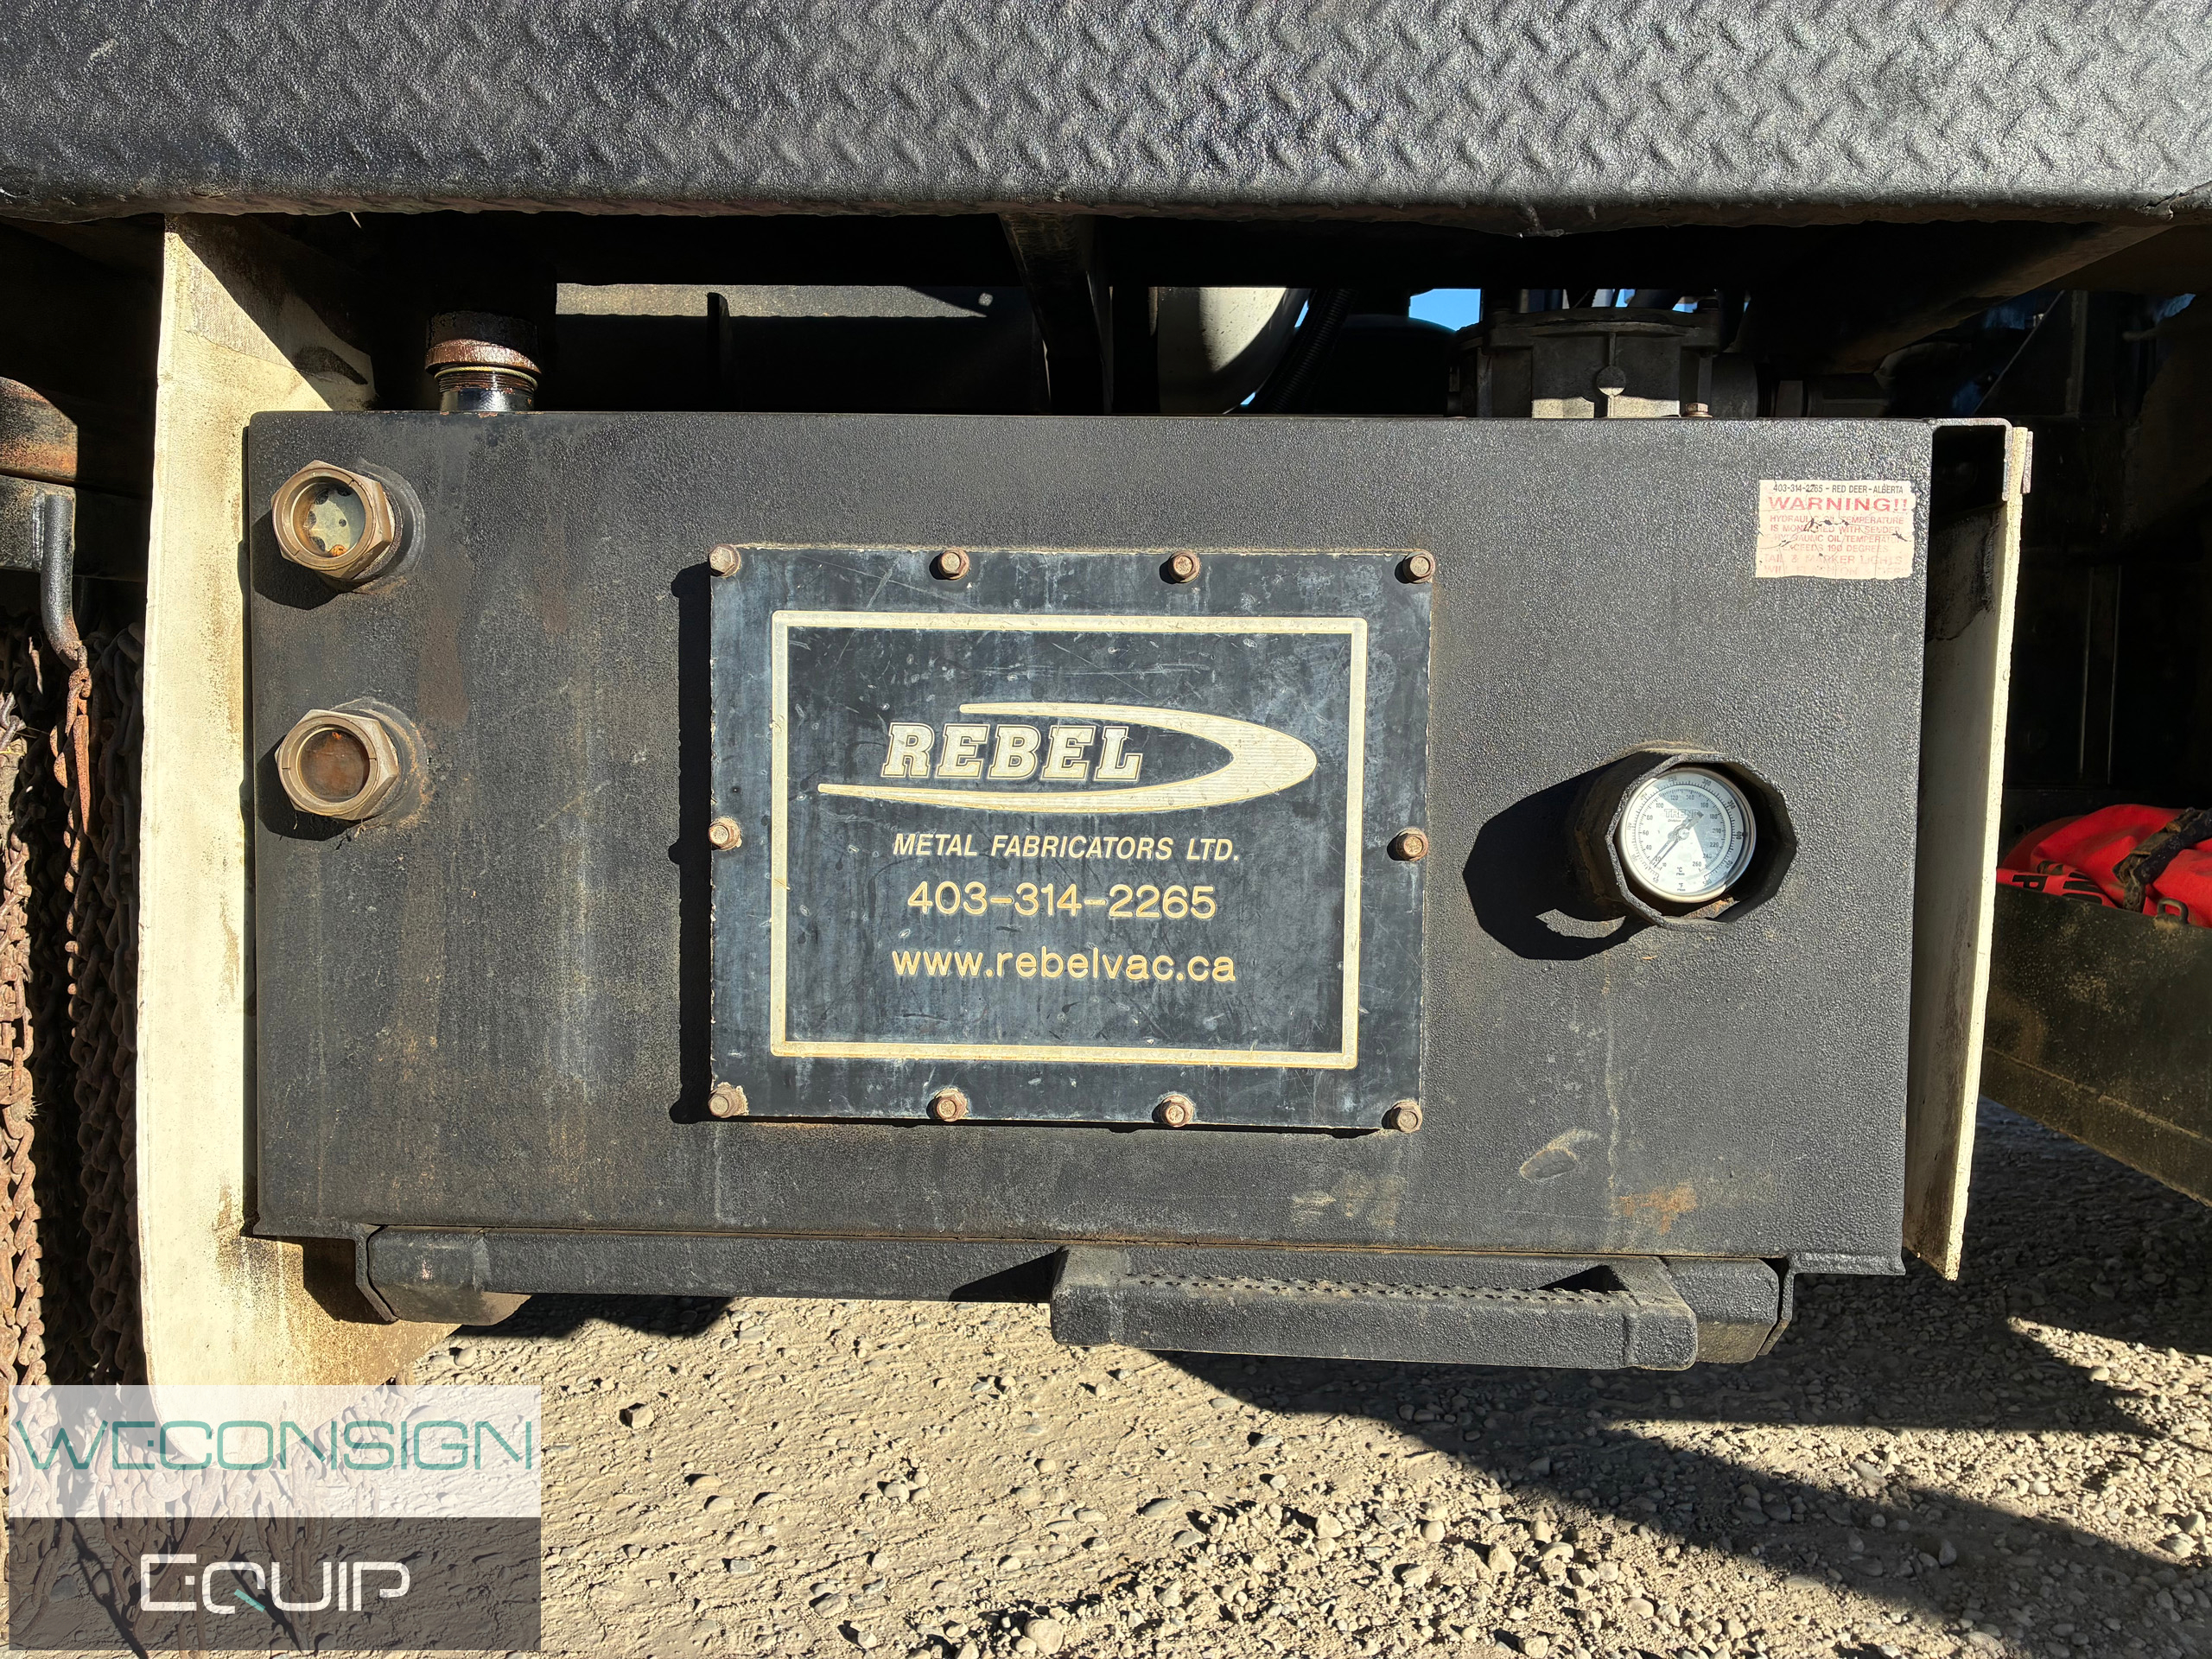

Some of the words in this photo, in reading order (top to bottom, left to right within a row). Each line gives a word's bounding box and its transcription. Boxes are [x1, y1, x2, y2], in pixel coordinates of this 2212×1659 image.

[1773, 484, 1823, 493] 403-314-2265
[1832, 485, 1846, 493] RED
[1768, 496, 1908, 512] WARNING!!
[1827, 534, 1840, 543] OIL
[1847, 544, 1889, 553] DEGREES
[881, 721, 1143, 782] REBEL
[893, 833, 977, 857] METAL
[990, 835, 1173, 861] FABRICATORS
[1186, 838, 1239, 861] LTD.
[906, 880, 1217, 920] 403-314-2265
[892, 944, 1237, 982] www.rebelvac.ca
